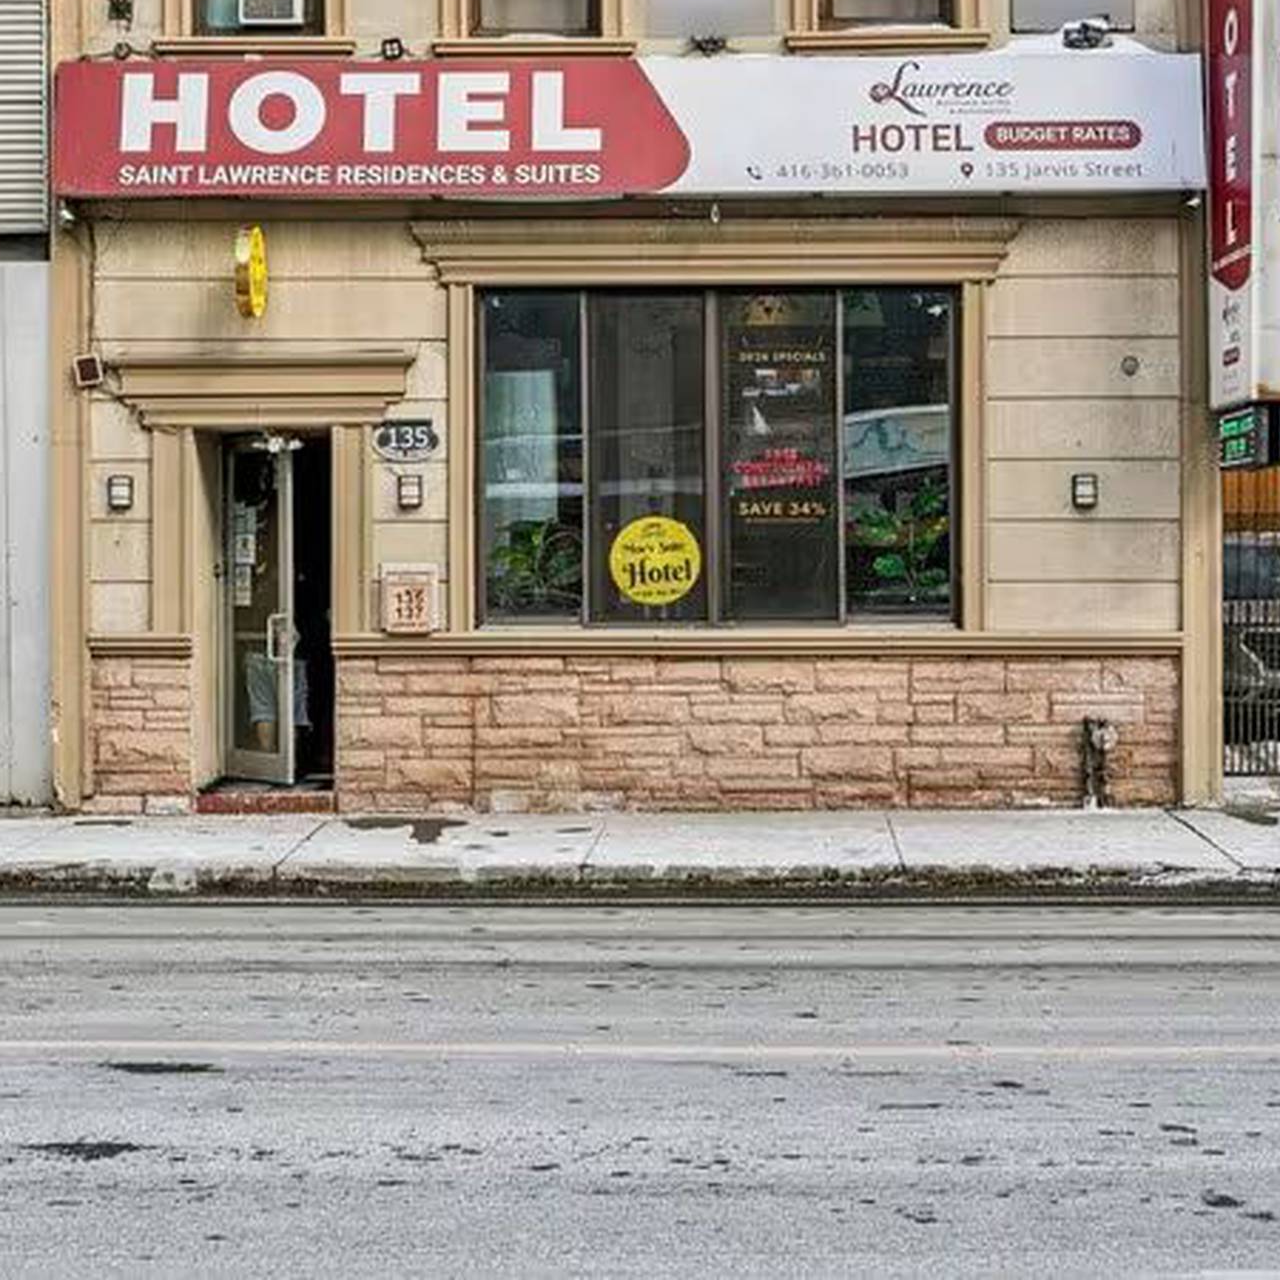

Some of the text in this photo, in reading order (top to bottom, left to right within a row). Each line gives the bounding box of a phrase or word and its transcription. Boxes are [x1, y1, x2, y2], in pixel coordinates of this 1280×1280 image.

[870, 60, 1014, 117] Lawrence
[120, 70, 602, 154] HOTEL
[853, 125, 974, 153] HOTEL
[997, 127, 1131, 142] BUDGET RATES
[119, 164, 601, 186] SAINT LAWRENCE RESIDENCES & SUITES
[776, 164, 910, 179] 416-361-0053
[986, 162, 1144, 180] 135 Jarvis Street
[389, 426, 429, 448] 135
[739, 502, 783, 517] SAVE
[623, 556, 692, 589] Hotel
